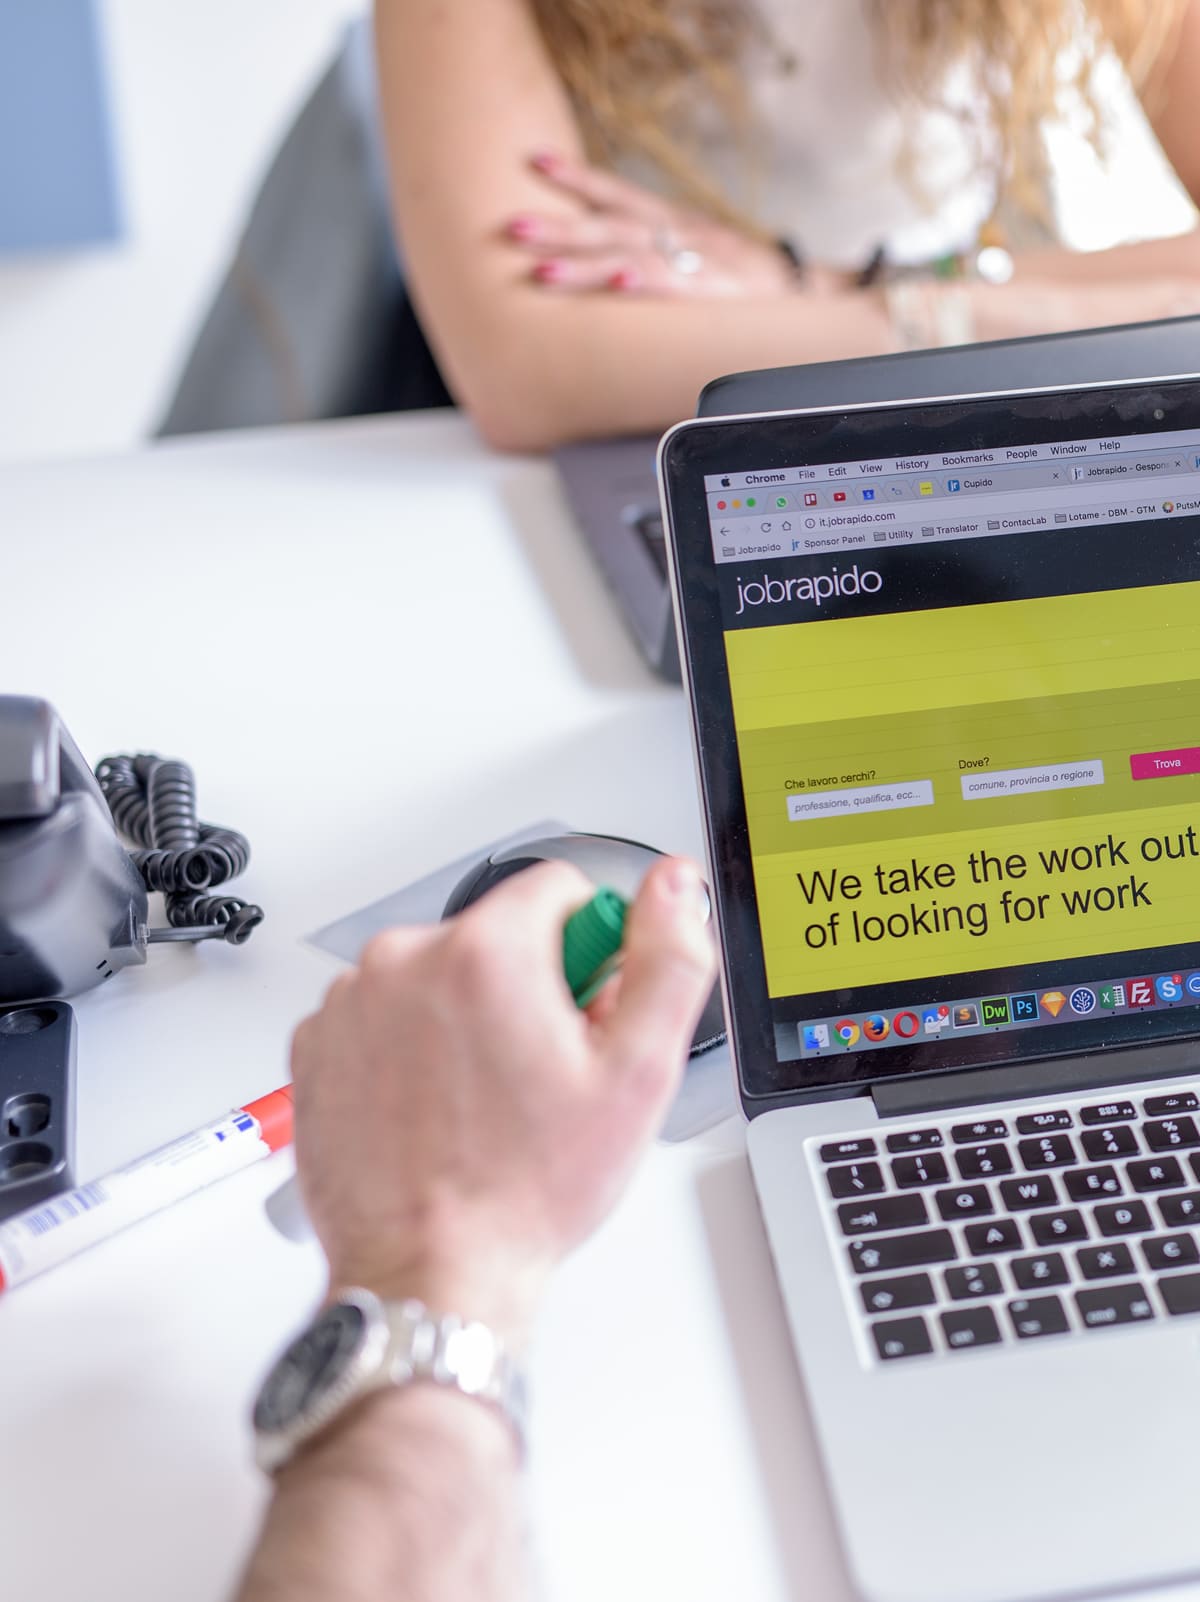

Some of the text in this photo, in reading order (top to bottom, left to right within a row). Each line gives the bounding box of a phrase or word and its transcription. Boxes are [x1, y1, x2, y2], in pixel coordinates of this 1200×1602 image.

[745, 441, 1120, 484] Chrome File Edit View History Bookmarks People Window Help
[1087, 466, 1127, 476] Jobrapido
[964, 479, 992, 489] Cupido
[819, 512, 895, 527] it.jobrapido.com
[1069, 511, 1099, 521] Lotame
[1108, 508, 1127, 517] DBM
[1136, 505, 1155, 514] GTM
[936, 524, 978, 534] Translator
[1002, 516, 1046, 528] ContacLab
[804, 537, 839, 549] Sponsor
[842, 534, 865, 544] Panel
[889, 530, 913, 540] Utility
[738, 543, 781, 555] Jobrapido
[736, 565, 882, 615] jobrapido
[958, 757, 989, 769] Dove?
[1154, 758, 1181, 769] Trova
[785, 770, 876, 790] Che lavoro cerchi?
[969, 780, 1007, 792] comune,
[1010, 773, 1049, 788] provincia
[1061, 769, 1094, 781] regione
[795, 792, 921, 814] professione, qualifica, ecc...
[797, 825, 1199, 904] We take the work out
[804, 875, 1152, 949] of looking for work
[1103, 992, 1110, 1003] X
[1131, 982, 1150, 1003] Fz
[1162, 981, 1176, 998] S
[985, 1004, 1006, 1018] Dw
[1017, 1000, 1032, 1014] Ps
[980, 1160, 992, 1171] 2
[1044, 1151, 1056, 1162] 3
[1170, 1133, 1181, 1143] 5
[956, 1194, 975, 1207] Q
[1018, 1184, 1038, 1198] W
[1087, 1175, 1100, 1188] E
[1150, 1166, 1164, 1179] R
[986, 1228, 1004, 1243] A
[1052, 1219, 1067, 1233] S
[1115, 1209, 1132, 1223] D
[1181, 1200, 1193, 1213] F
[1098, 1252, 1116, 1268] X
[1164, 1242, 1181, 1257] C
